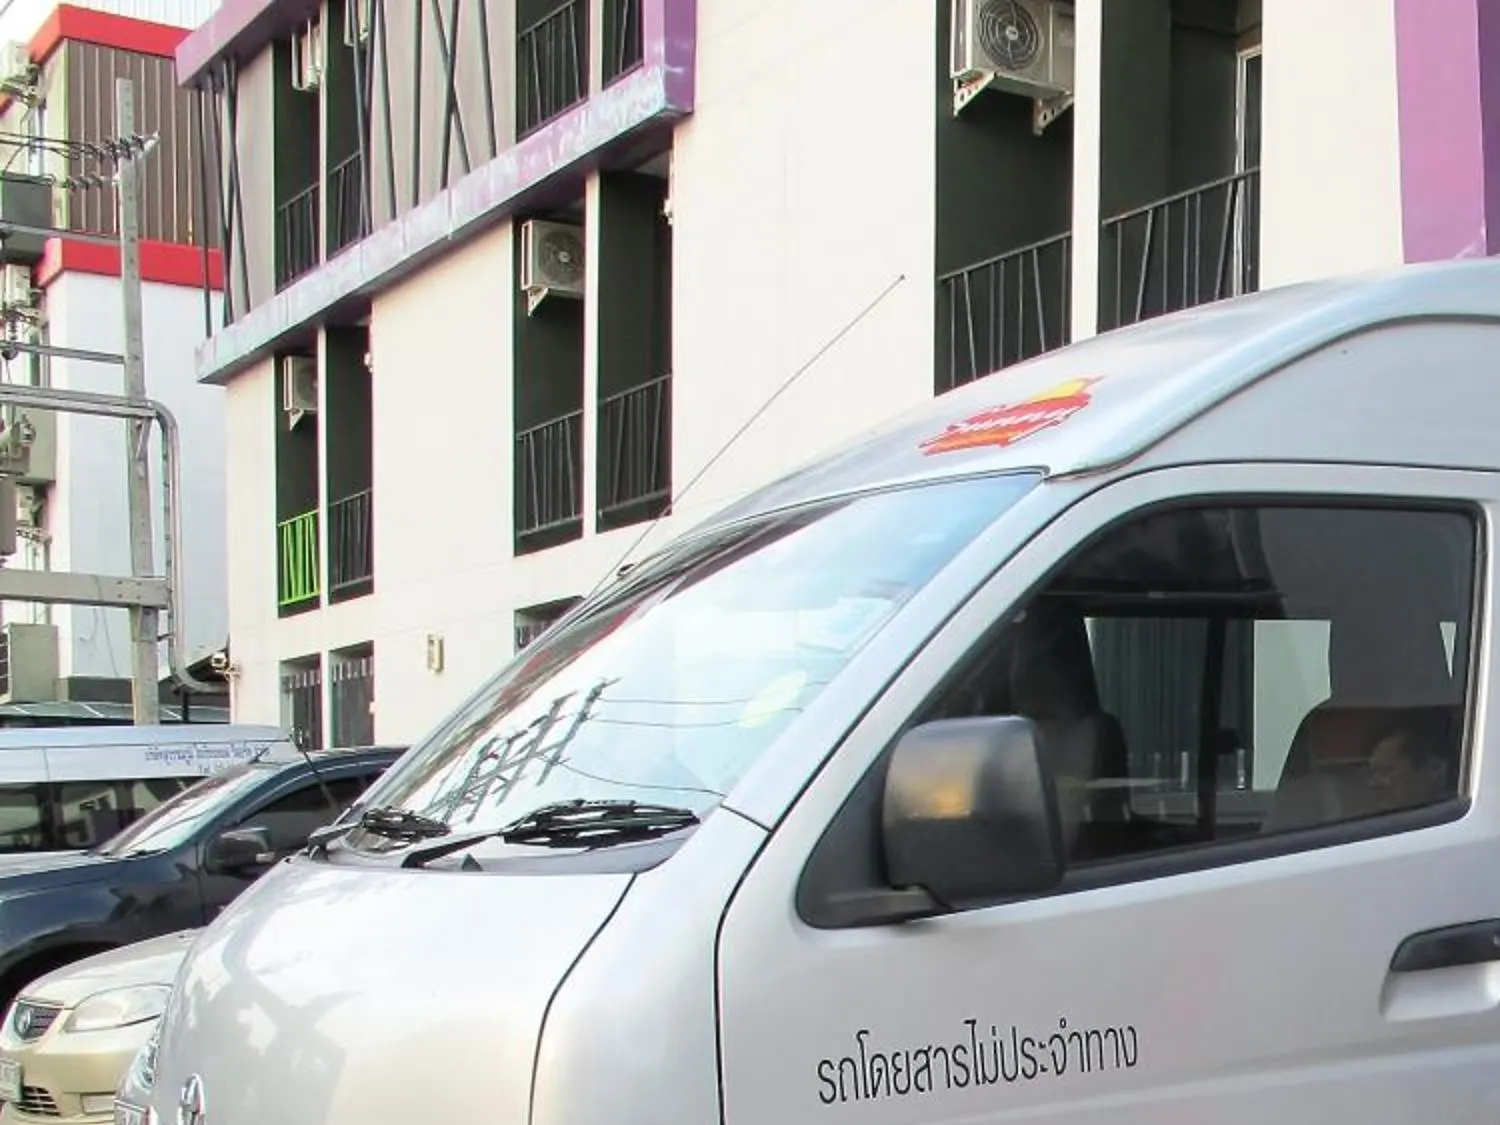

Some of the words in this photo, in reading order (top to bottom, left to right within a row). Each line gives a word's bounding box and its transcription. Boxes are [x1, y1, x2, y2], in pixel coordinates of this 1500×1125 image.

[817, 1017, 1137, 1104] รถโดยสารไม่ประจำทาง
